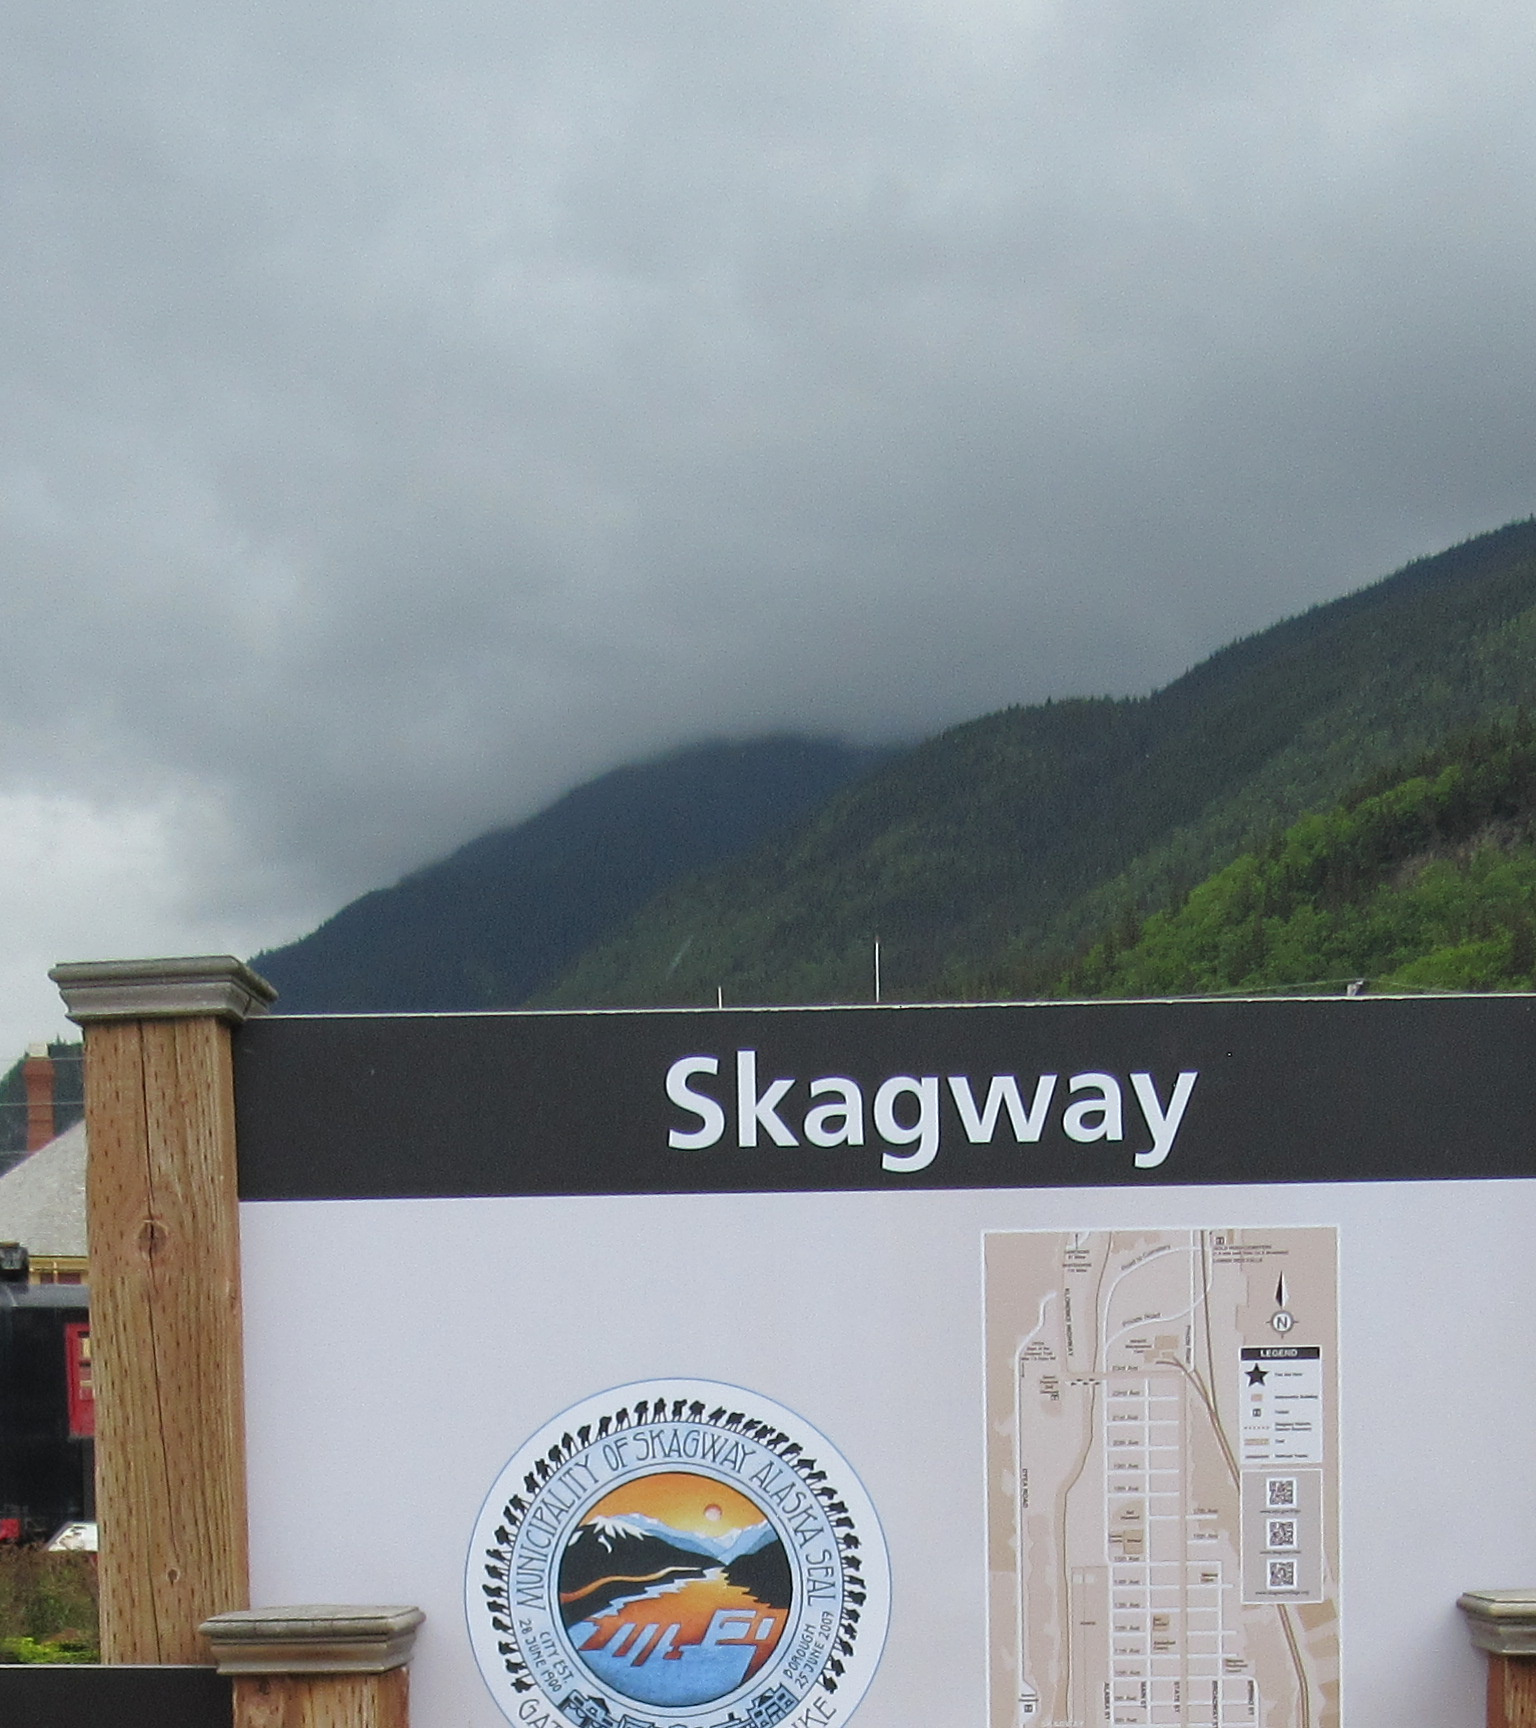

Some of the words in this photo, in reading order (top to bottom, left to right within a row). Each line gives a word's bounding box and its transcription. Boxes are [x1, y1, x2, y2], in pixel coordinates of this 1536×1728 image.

[664, 1050, 1199, 1173] Skagway
[1260, 1348, 1298, 1358] LEGEND
[1276, 1316, 1288, 1328] N
[515, 1454, 599, 1610] MUNICIPALITY
[602, 1437, 629, 1471] OF
[633, 1429, 757, 1474] SKAGWAY
[748, 1461, 827, 1548] ALASKA
[806, 1549, 836, 1607] SEAL
[519, 1618, 532, 1634] 28
[526, 1635, 547, 1669] JUNE
[540, 1668, 562, 1693] 1900
[539, 1630, 560, 1663] CITY
[553, 1659, 574, 1684] EST.
[783, 1623, 816, 1679] BOROUGH
[794, 1673, 809, 1690] 25
[805, 1641, 825, 1673] JUNE
[820, 1610, 835, 1641] 2007
